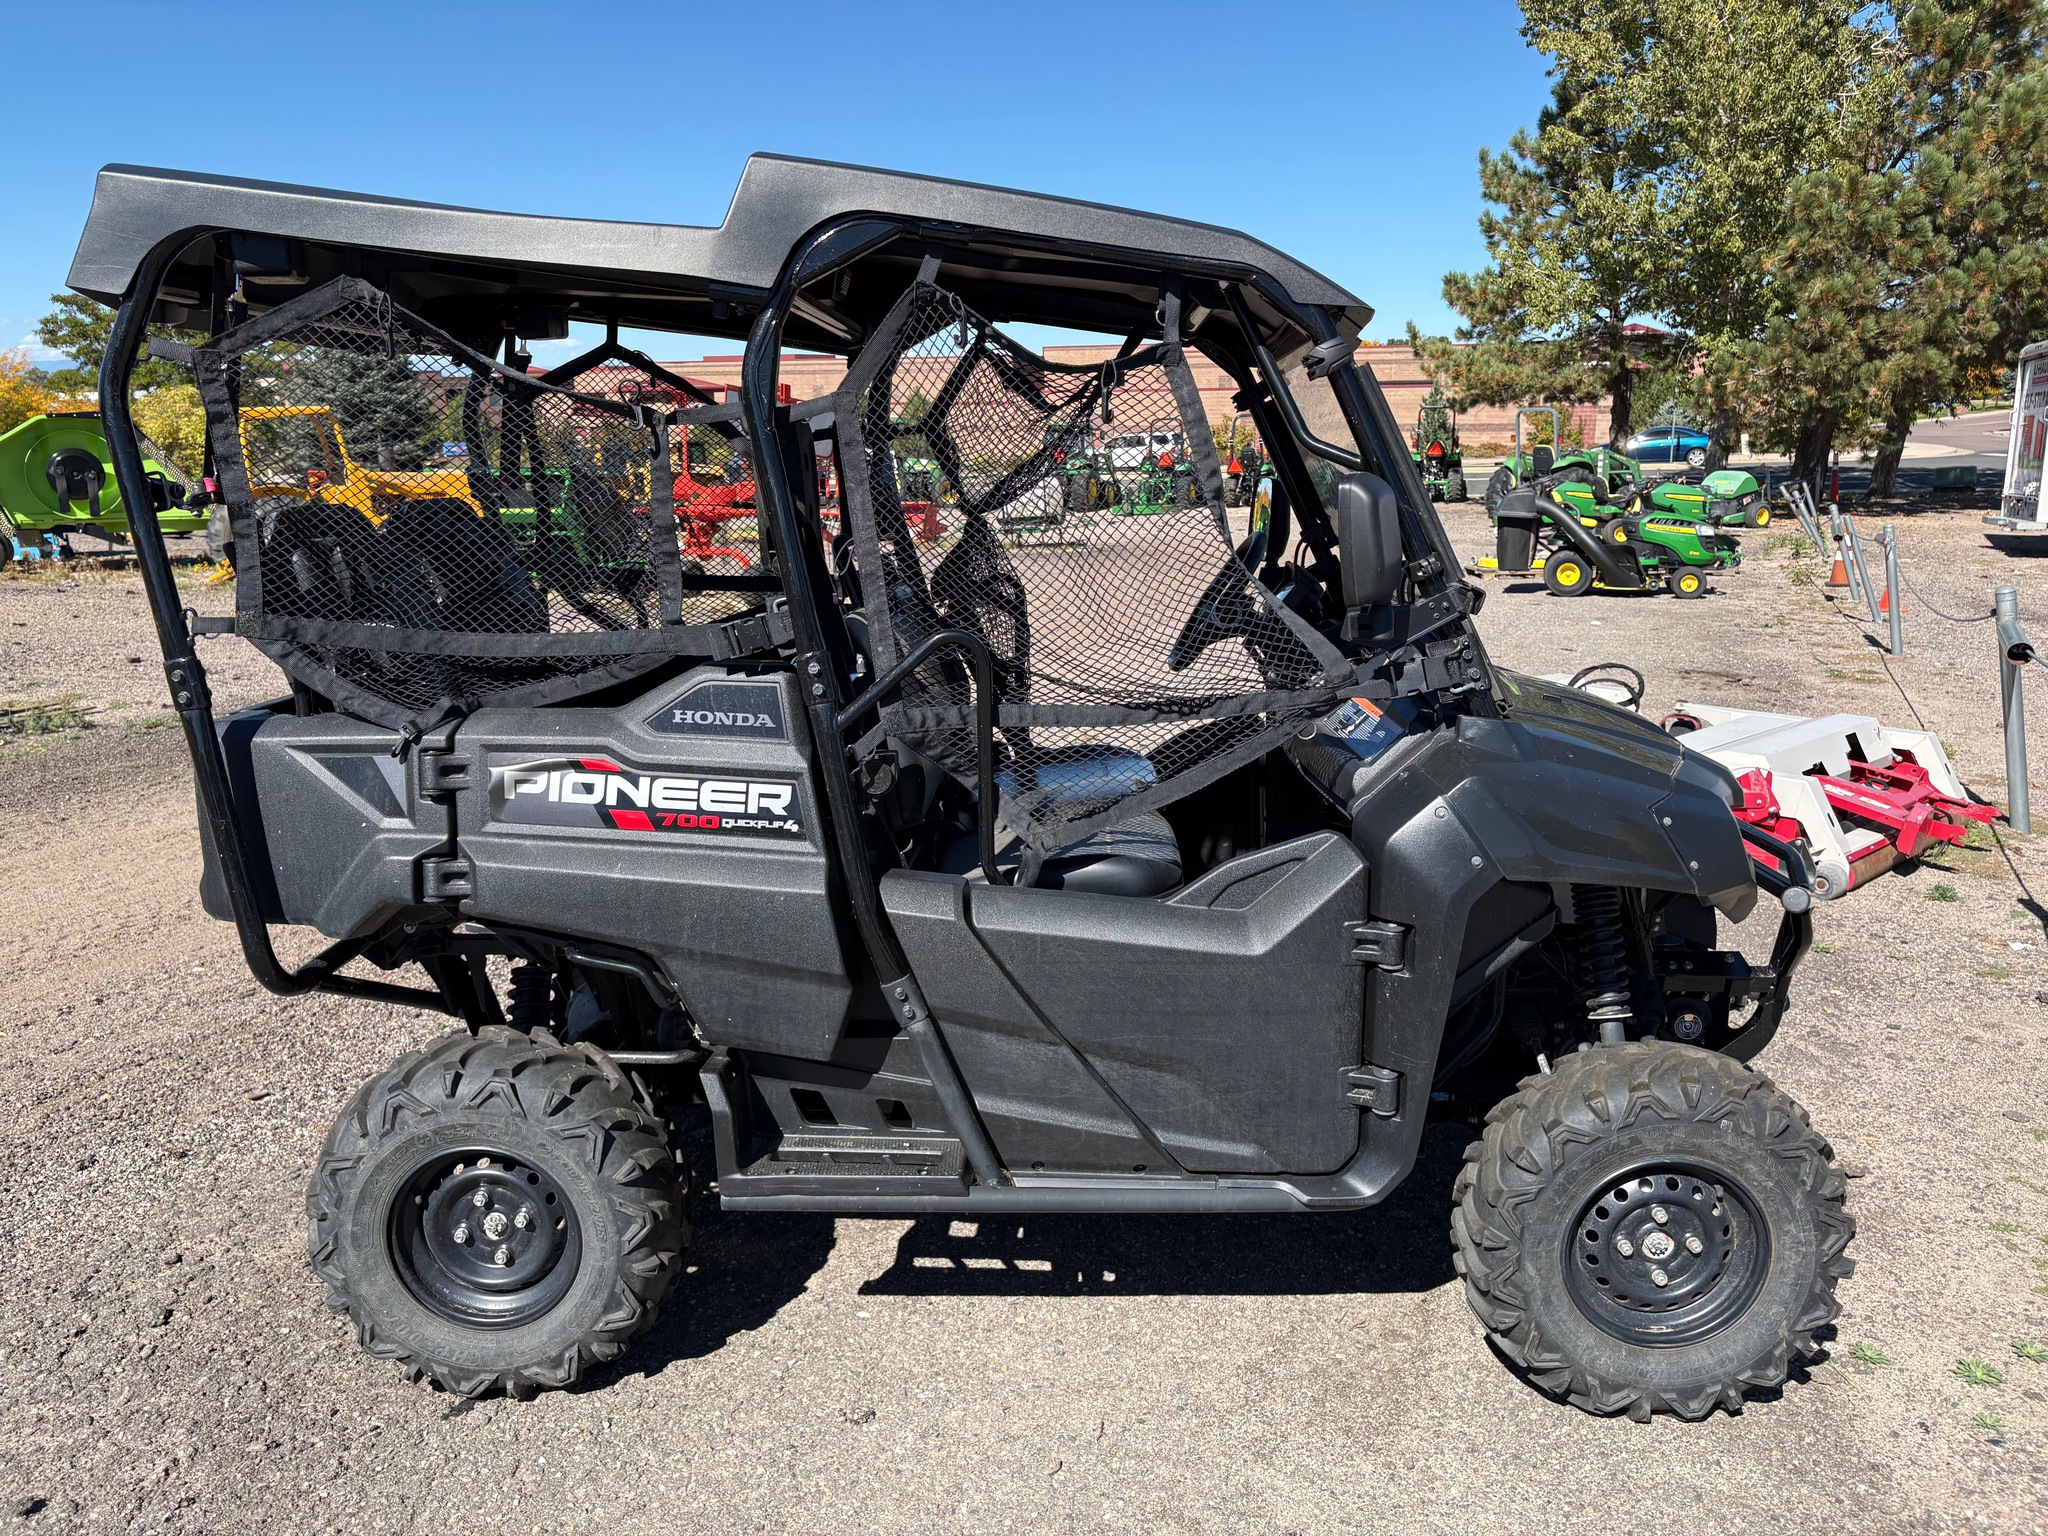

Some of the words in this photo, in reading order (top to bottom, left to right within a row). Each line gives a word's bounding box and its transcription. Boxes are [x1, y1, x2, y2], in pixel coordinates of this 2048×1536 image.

[672, 709, 776, 728] HONDA
[504, 769, 793, 816] PIONEER
[656, 812, 721, 829] 700
